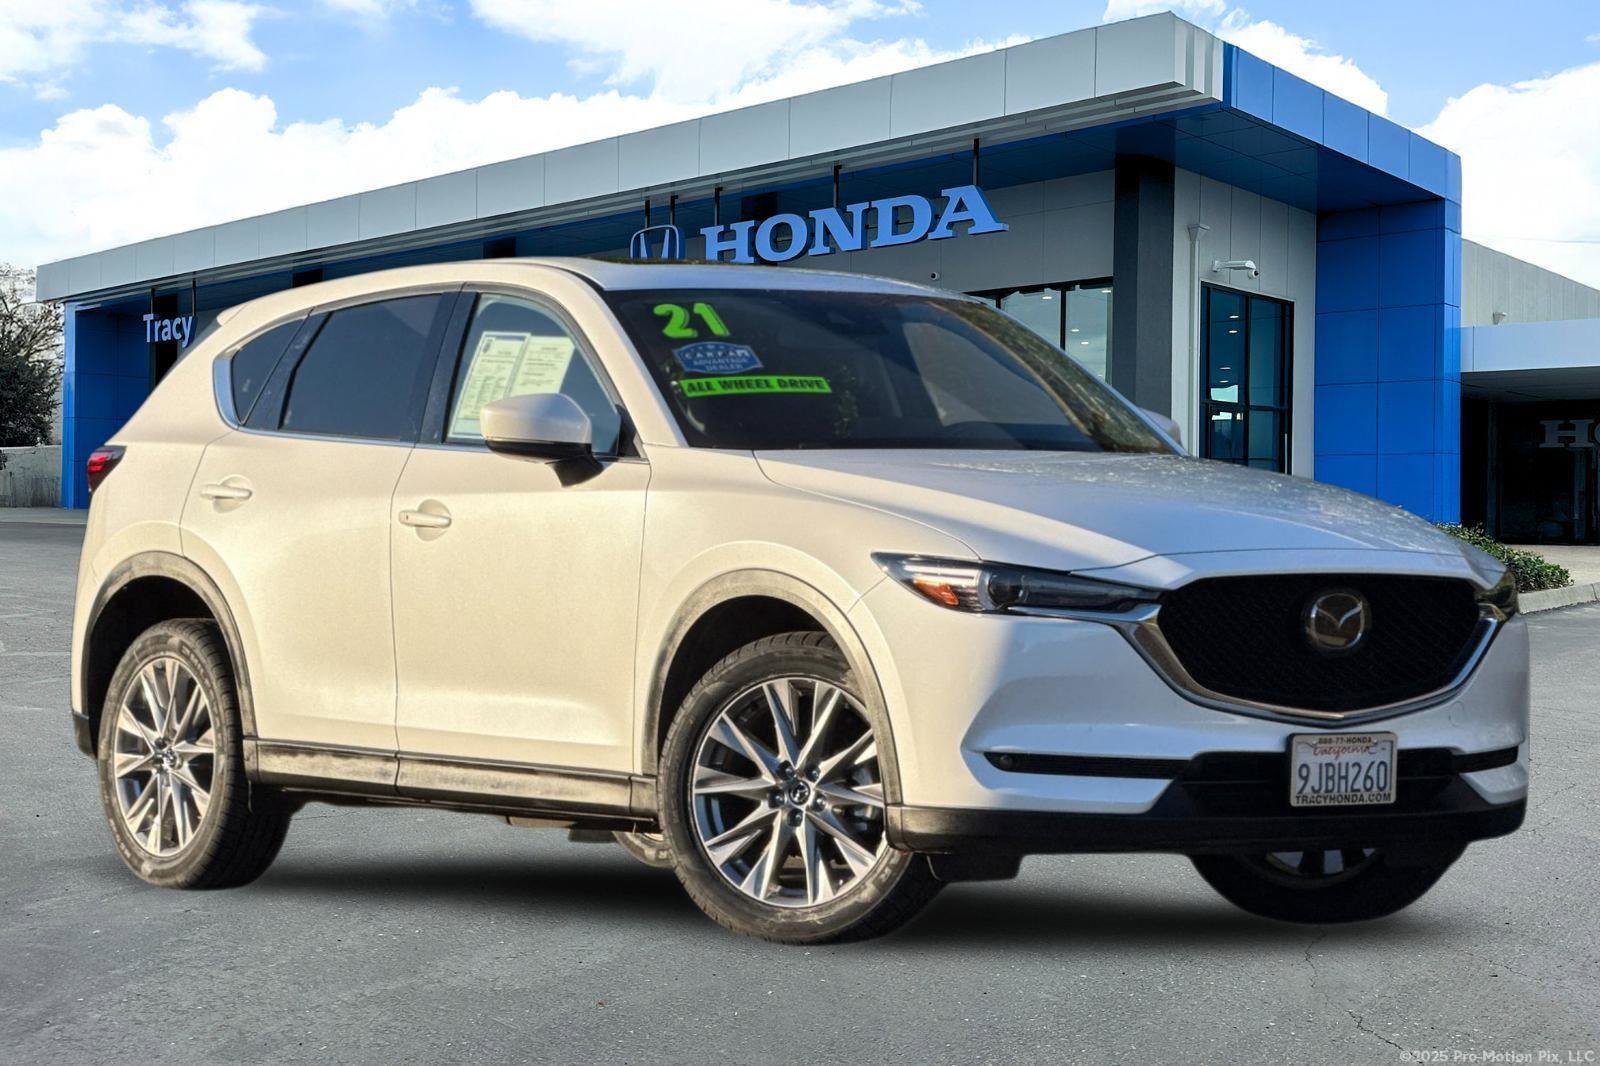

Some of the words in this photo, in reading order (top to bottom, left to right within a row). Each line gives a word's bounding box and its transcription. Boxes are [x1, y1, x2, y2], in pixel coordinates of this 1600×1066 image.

[700, 185, 1009, 264] HONDA
[143, 313, 193, 348] Tracy
[653, 303, 730, 338] 21
[686, 383, 714, 393] ALL
[718, 380, 775, 391] WHEEL
[777, 379, 824, 390] DRIVE
[1540, 419, 1600, 448] H
[1313, 745, 1371, 761] California
[1298, 760, 1387, 794] 9JBH260
[1295, 793, 1391, 804] TRACYHONDA.COM
